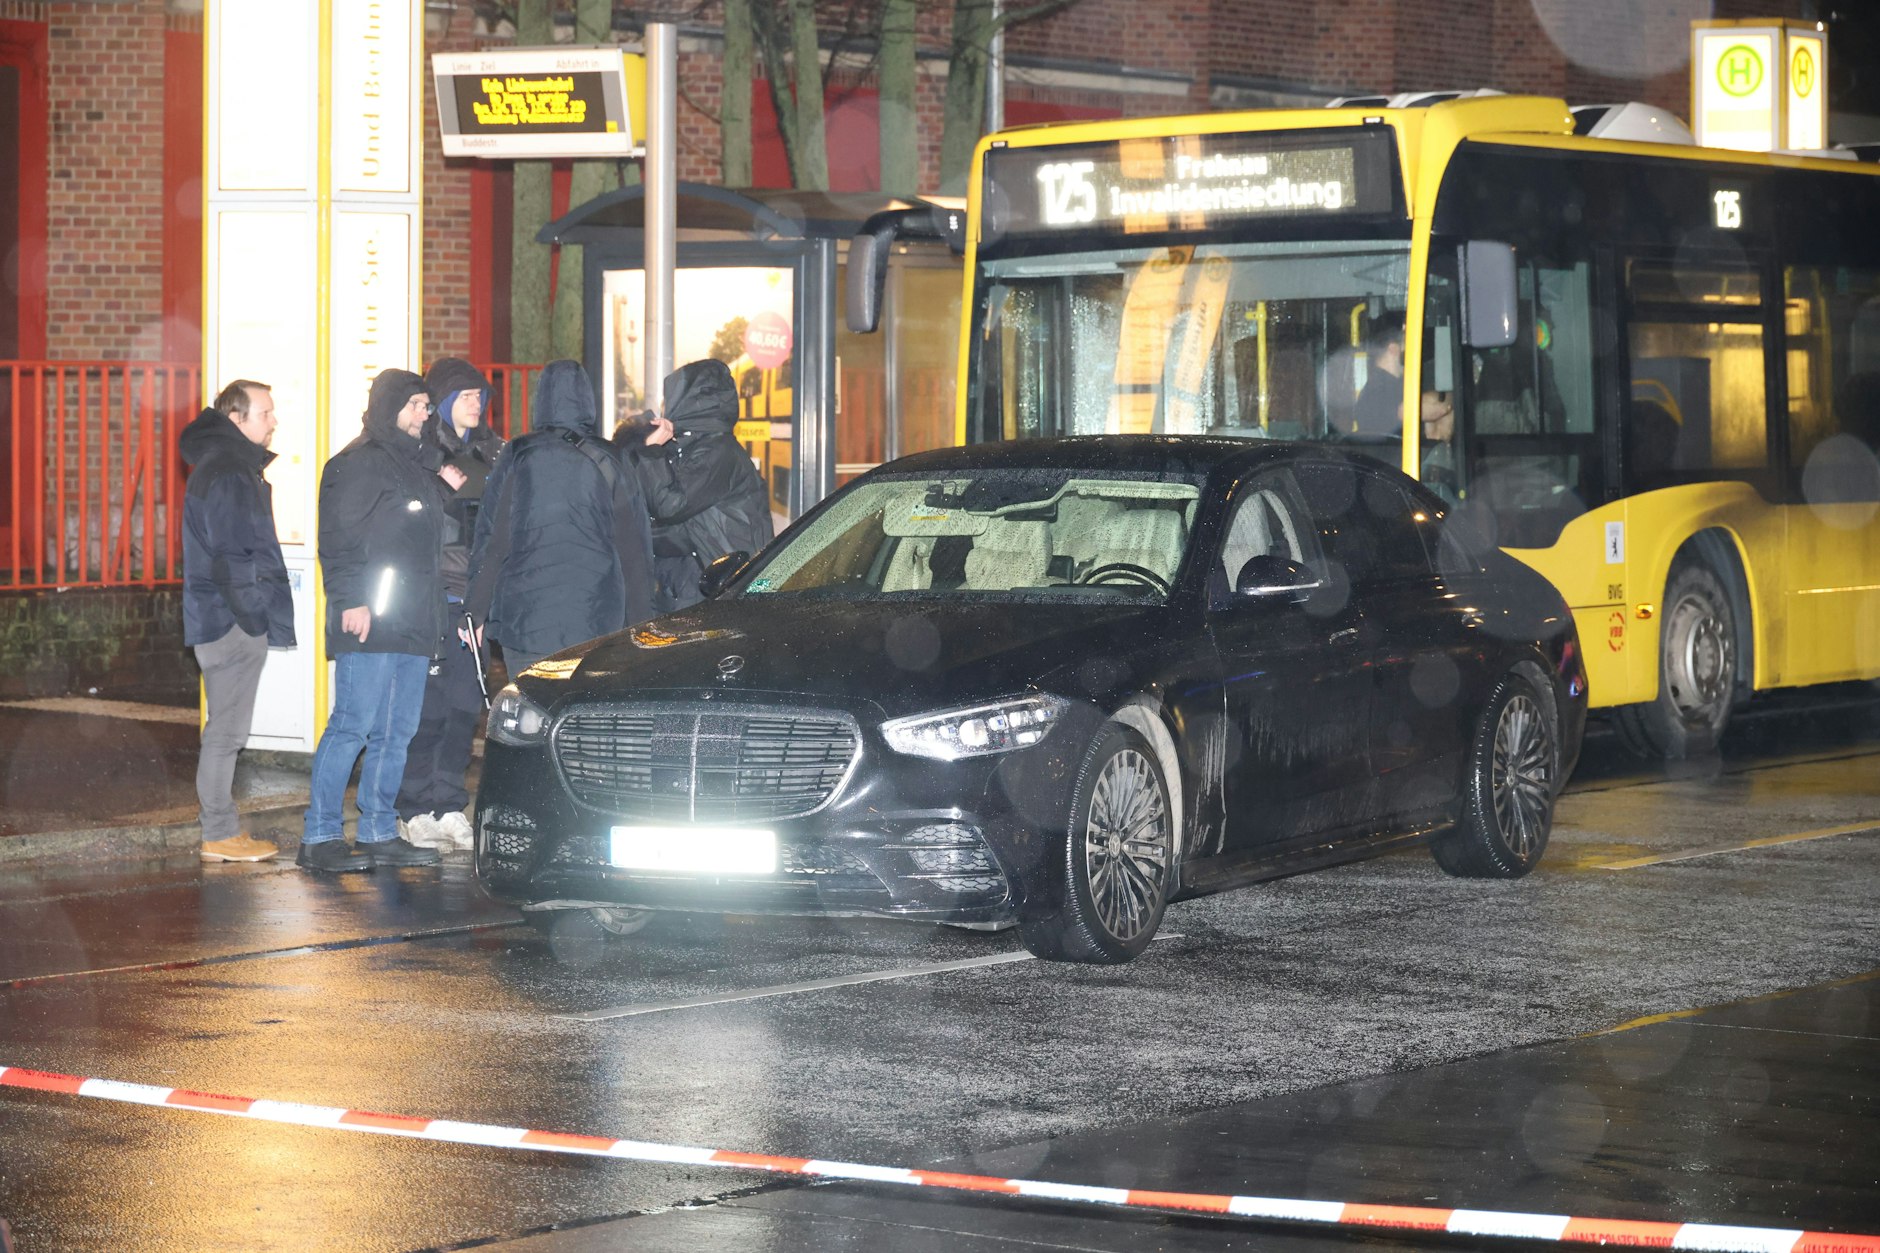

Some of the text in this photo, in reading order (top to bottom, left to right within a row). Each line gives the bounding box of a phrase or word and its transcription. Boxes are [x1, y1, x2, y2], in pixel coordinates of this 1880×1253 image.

[480, 60, 496, 71] Ziel
[1177, 154, 1267, 179] Frohnau
[1037, 160, 1097, 225] 125
[1111, 178, 1341, 214] Invalidensiedlung
[1714, 190, 1741, 228] 125
